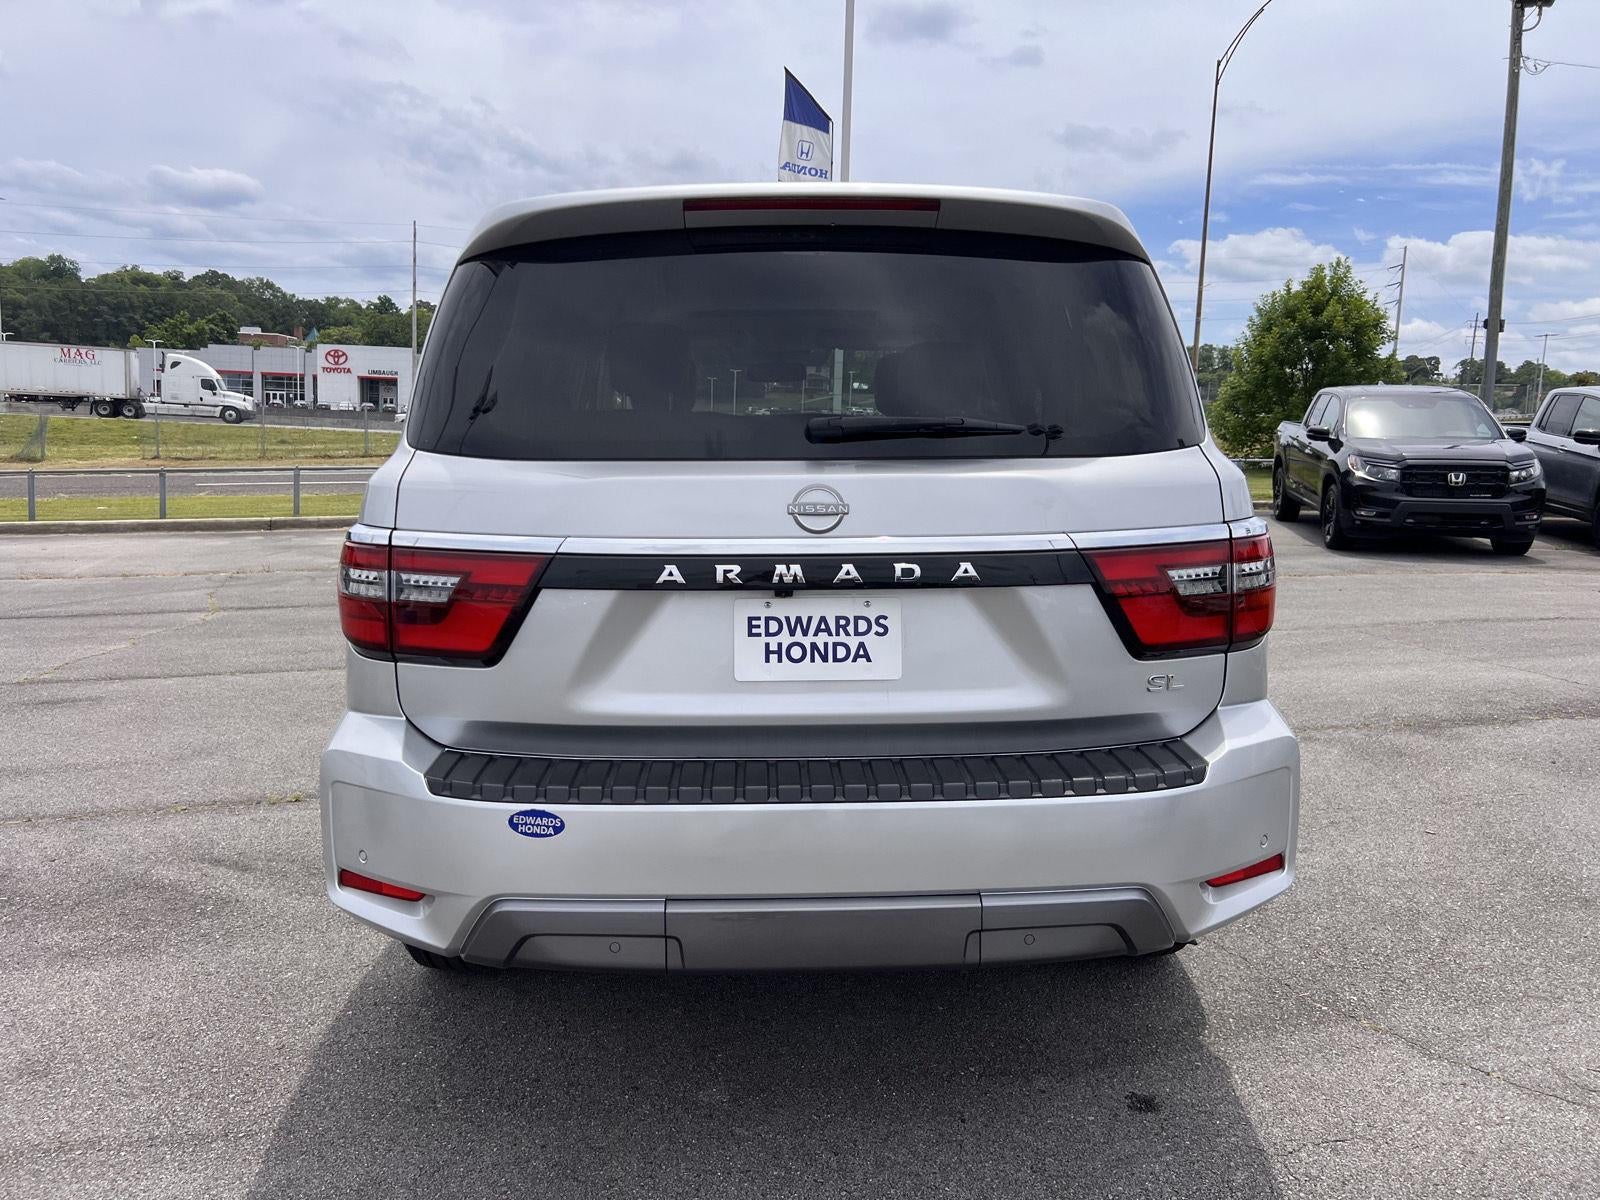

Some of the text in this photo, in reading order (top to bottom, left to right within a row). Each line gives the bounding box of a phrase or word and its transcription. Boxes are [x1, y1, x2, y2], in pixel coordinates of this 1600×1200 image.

[60, 347, 95, 360] MAG
[321, 366, 352, 374] TOYOTA
[788, 503, 848, 514] NISSAN
[655, 562, 981, 584] ARMADA
[747, 614, 889, 638] EDWARDS
[764, 640, 873, 664] HONDA
[1147, 674, 1184, 692] SL
[513, 815, 561, 827] EDWARDS
[518, 824, 555, 835] HONDA
